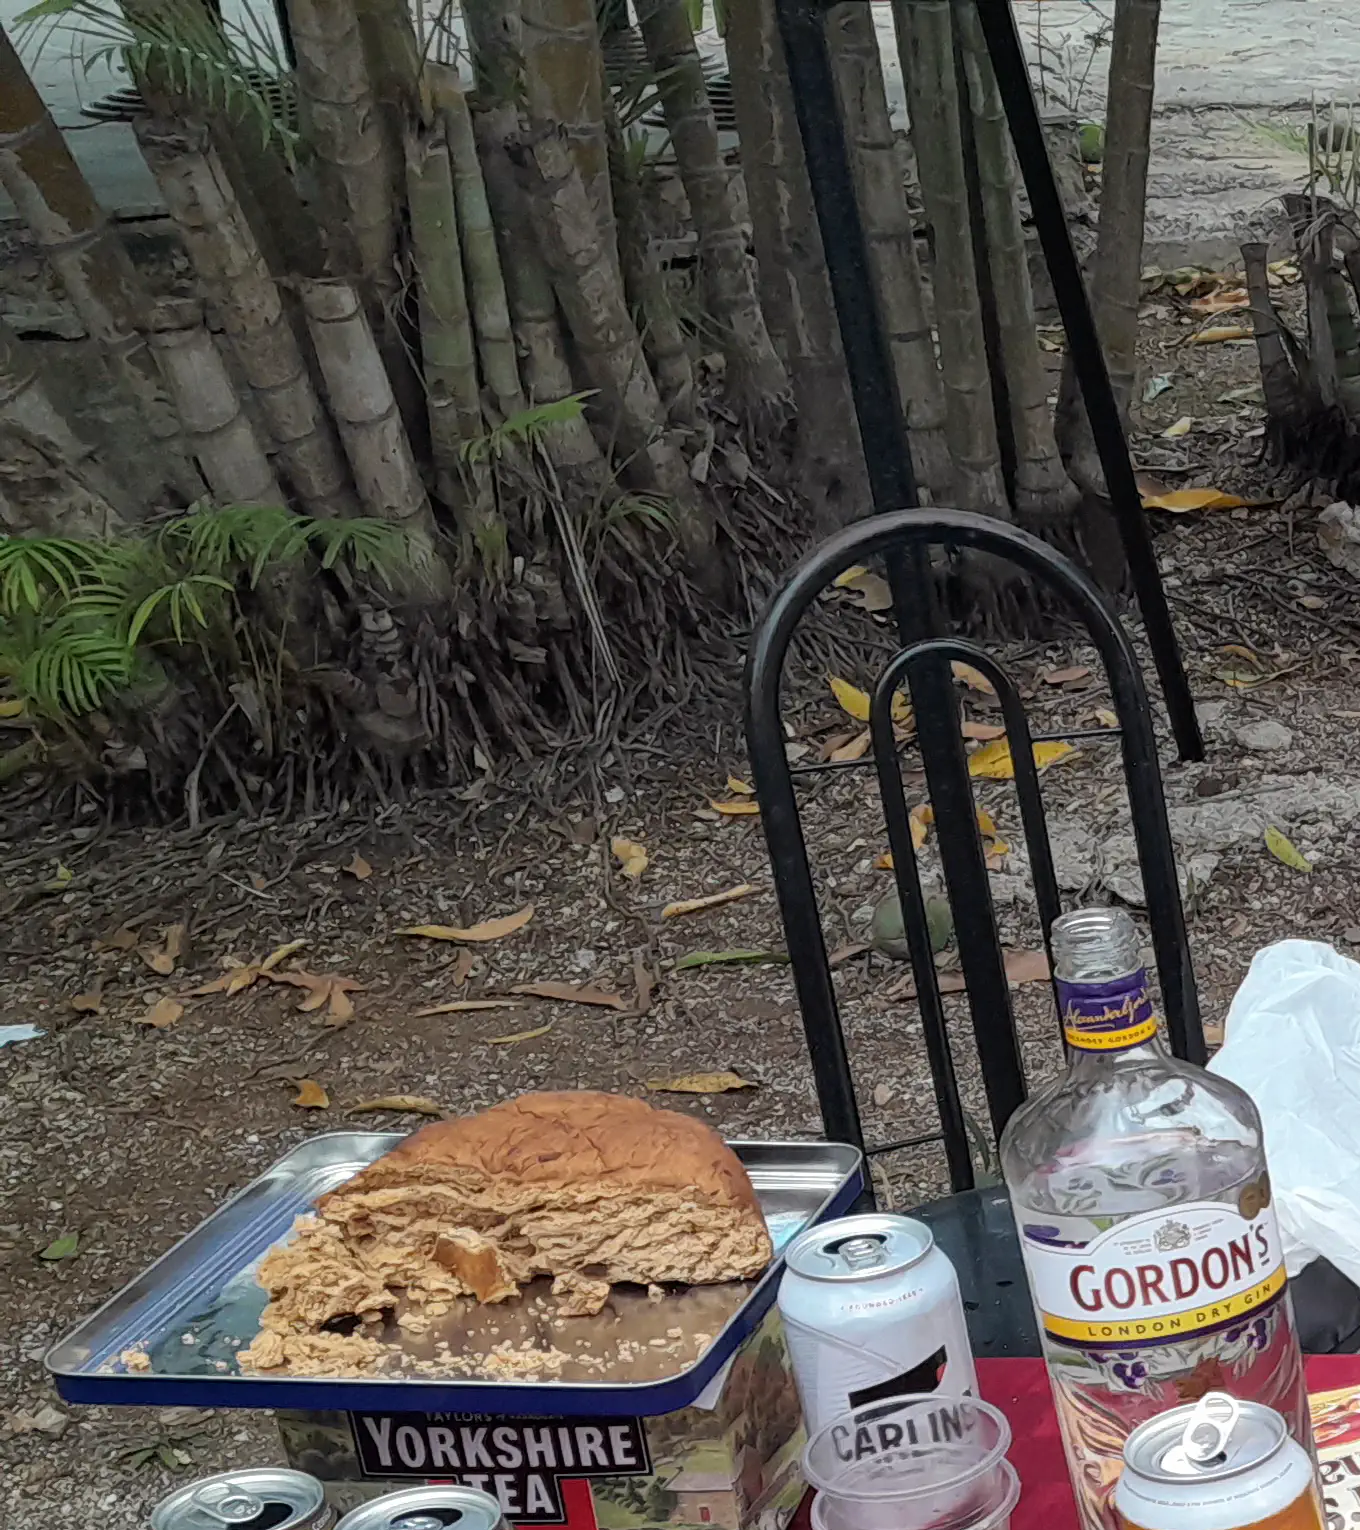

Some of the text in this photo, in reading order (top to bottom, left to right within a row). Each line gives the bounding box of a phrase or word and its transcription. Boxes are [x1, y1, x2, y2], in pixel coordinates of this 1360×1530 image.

[1069, 1223, 1270, 1313] GORDON'S
[1087, 1283, 1273, 1338] LONDON DRY GIN
[362, 1416, 636, 1471] YORKSHIRE
[457, 1473, 557, 1516] TEA
